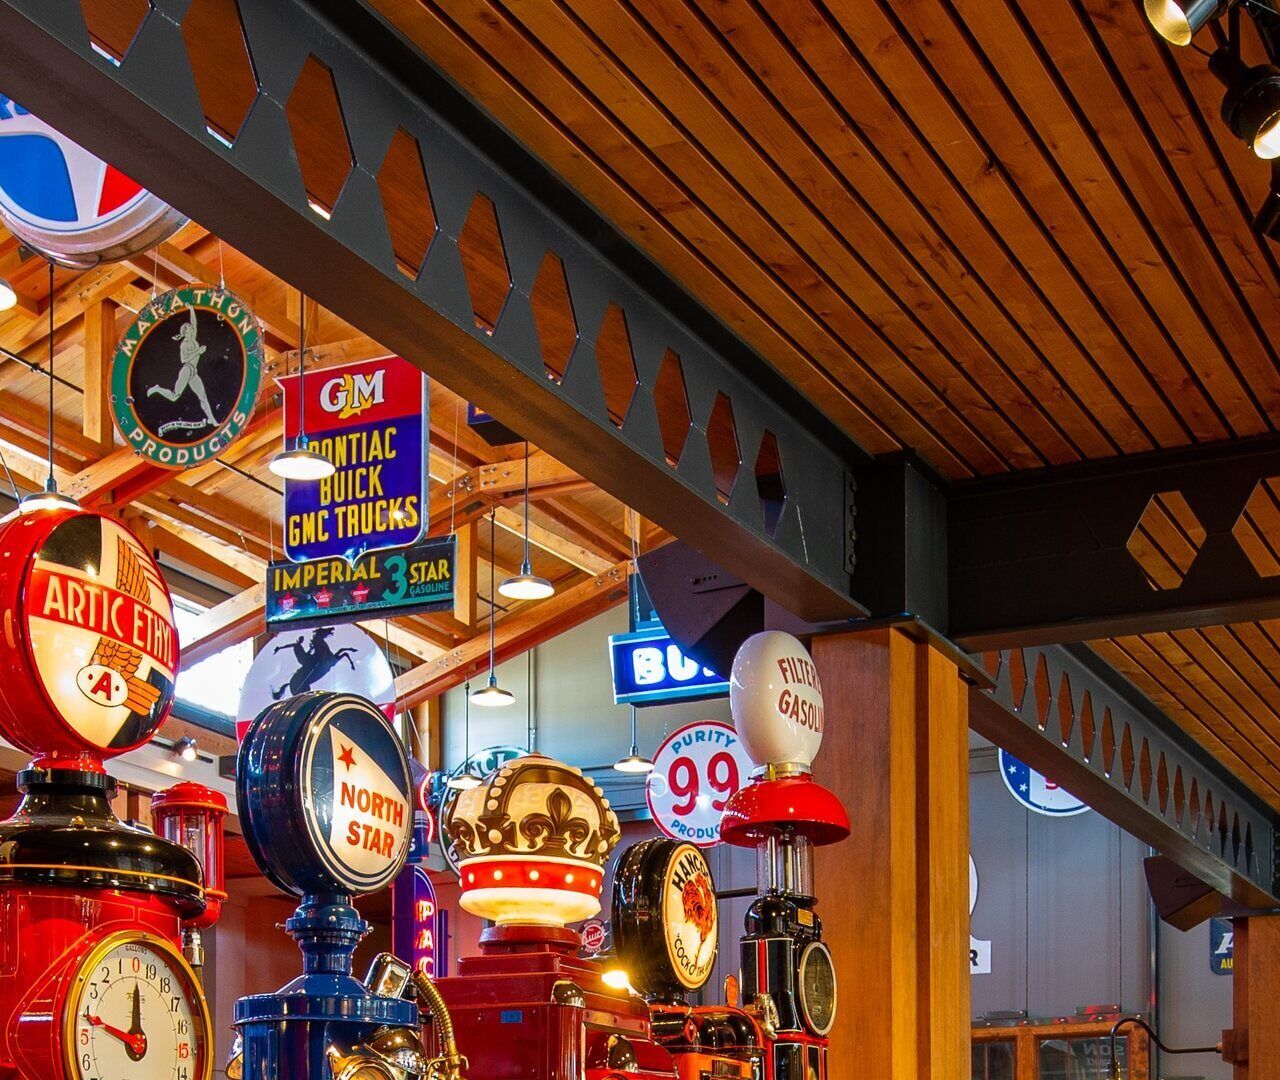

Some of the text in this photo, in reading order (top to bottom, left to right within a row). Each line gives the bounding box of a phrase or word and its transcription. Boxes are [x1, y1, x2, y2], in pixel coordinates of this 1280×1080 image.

[121, 287, 259, 357] MARATHON
[320, 368, 386, 413] GM
[128, 409, 247, 464] PRODUCTS
[309, 427, 397, 466] PONTIAC
[320, 465, 382, 506] BUICK
[289, 495, 420, 547] GMC TRUCKS
[274, 555, 451, 600] IMPERIAL 3 STAR
[409, 581, 451, 597] GASOLINE
[42, 574, 175, 668] ARTIC ETHYL
[90, 671, 113, 702] A
[671, 730, 737, 755] PURITY
[669, 751, 740, 816] 99
[340, 781, 404, 828] NORTH
[346, 819, 395, 860] STAR
[101, 966, 110, 984] 2
[131, 957, 141, 973] 0
[80, 1028, 89, 1046] 5
[177, 1018, 188, 1035] 16
